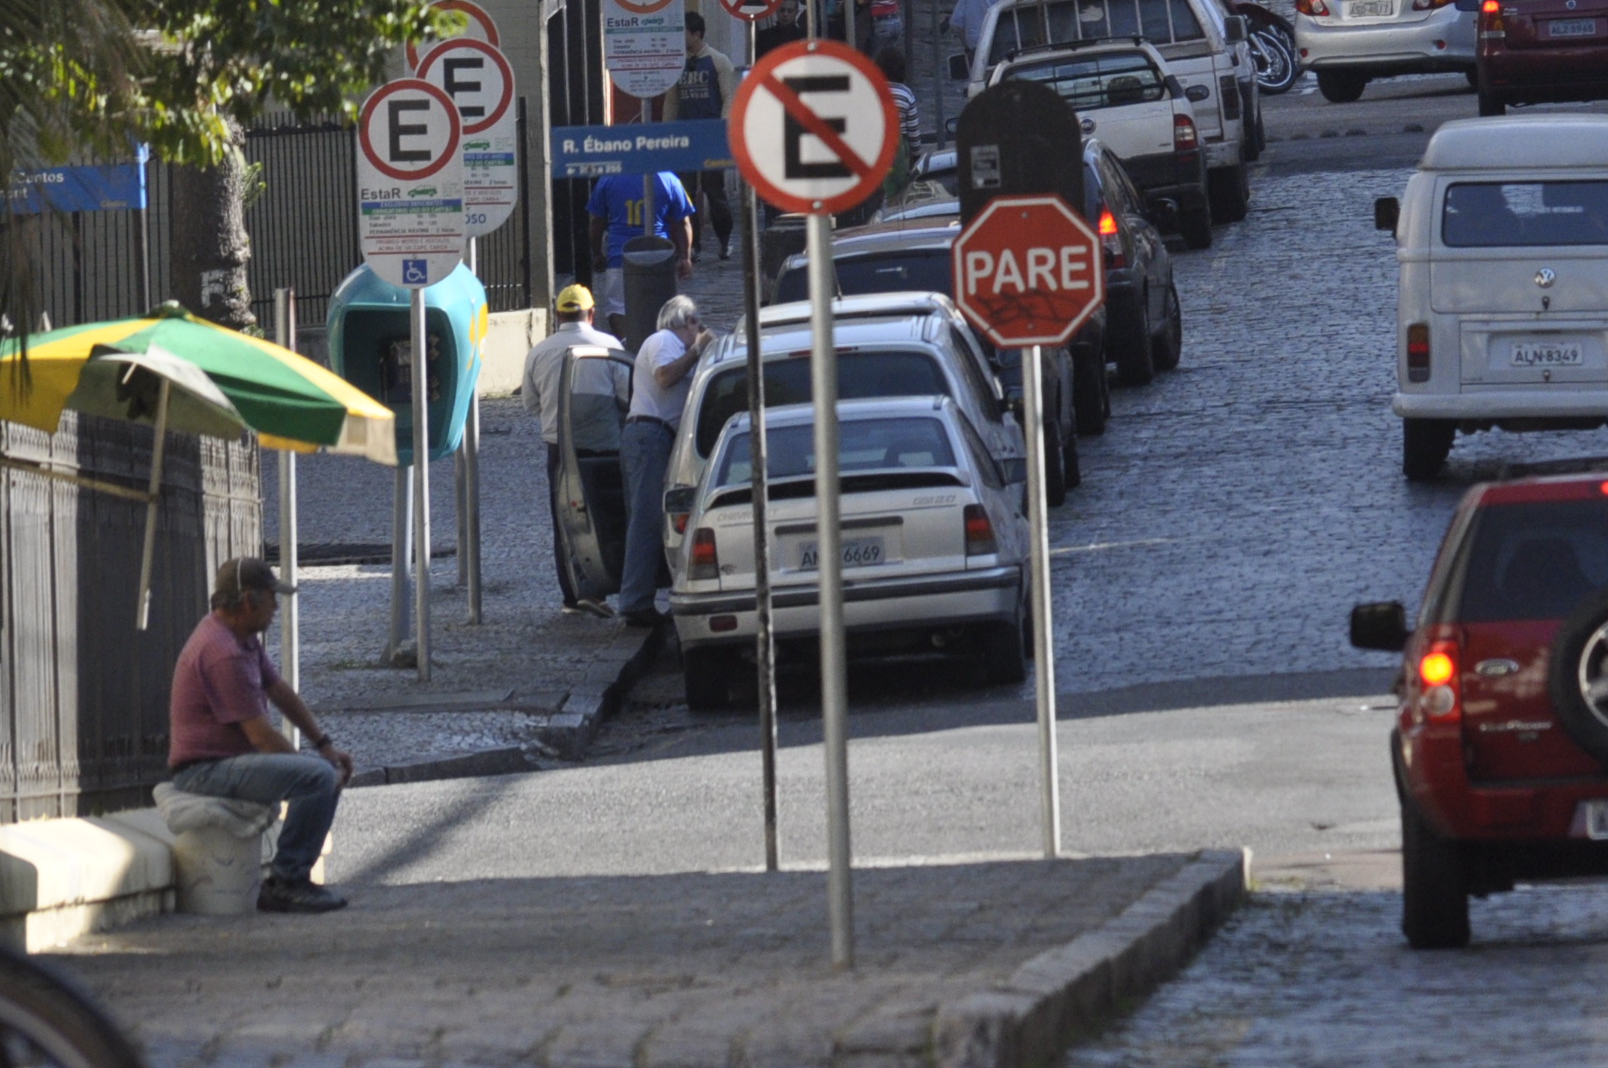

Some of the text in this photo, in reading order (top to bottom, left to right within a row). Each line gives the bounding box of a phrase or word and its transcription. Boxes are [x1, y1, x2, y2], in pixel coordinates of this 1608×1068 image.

[607, 17, 639, 28] EstaR
[443, 58, 484, 117] E
[388, 100, 431, 162] E
[563, 134, 690, 154] R. Ébano Pereira
[361, 188, 401, 200] EstaR
[965, 244, 1090, 296] PARE
